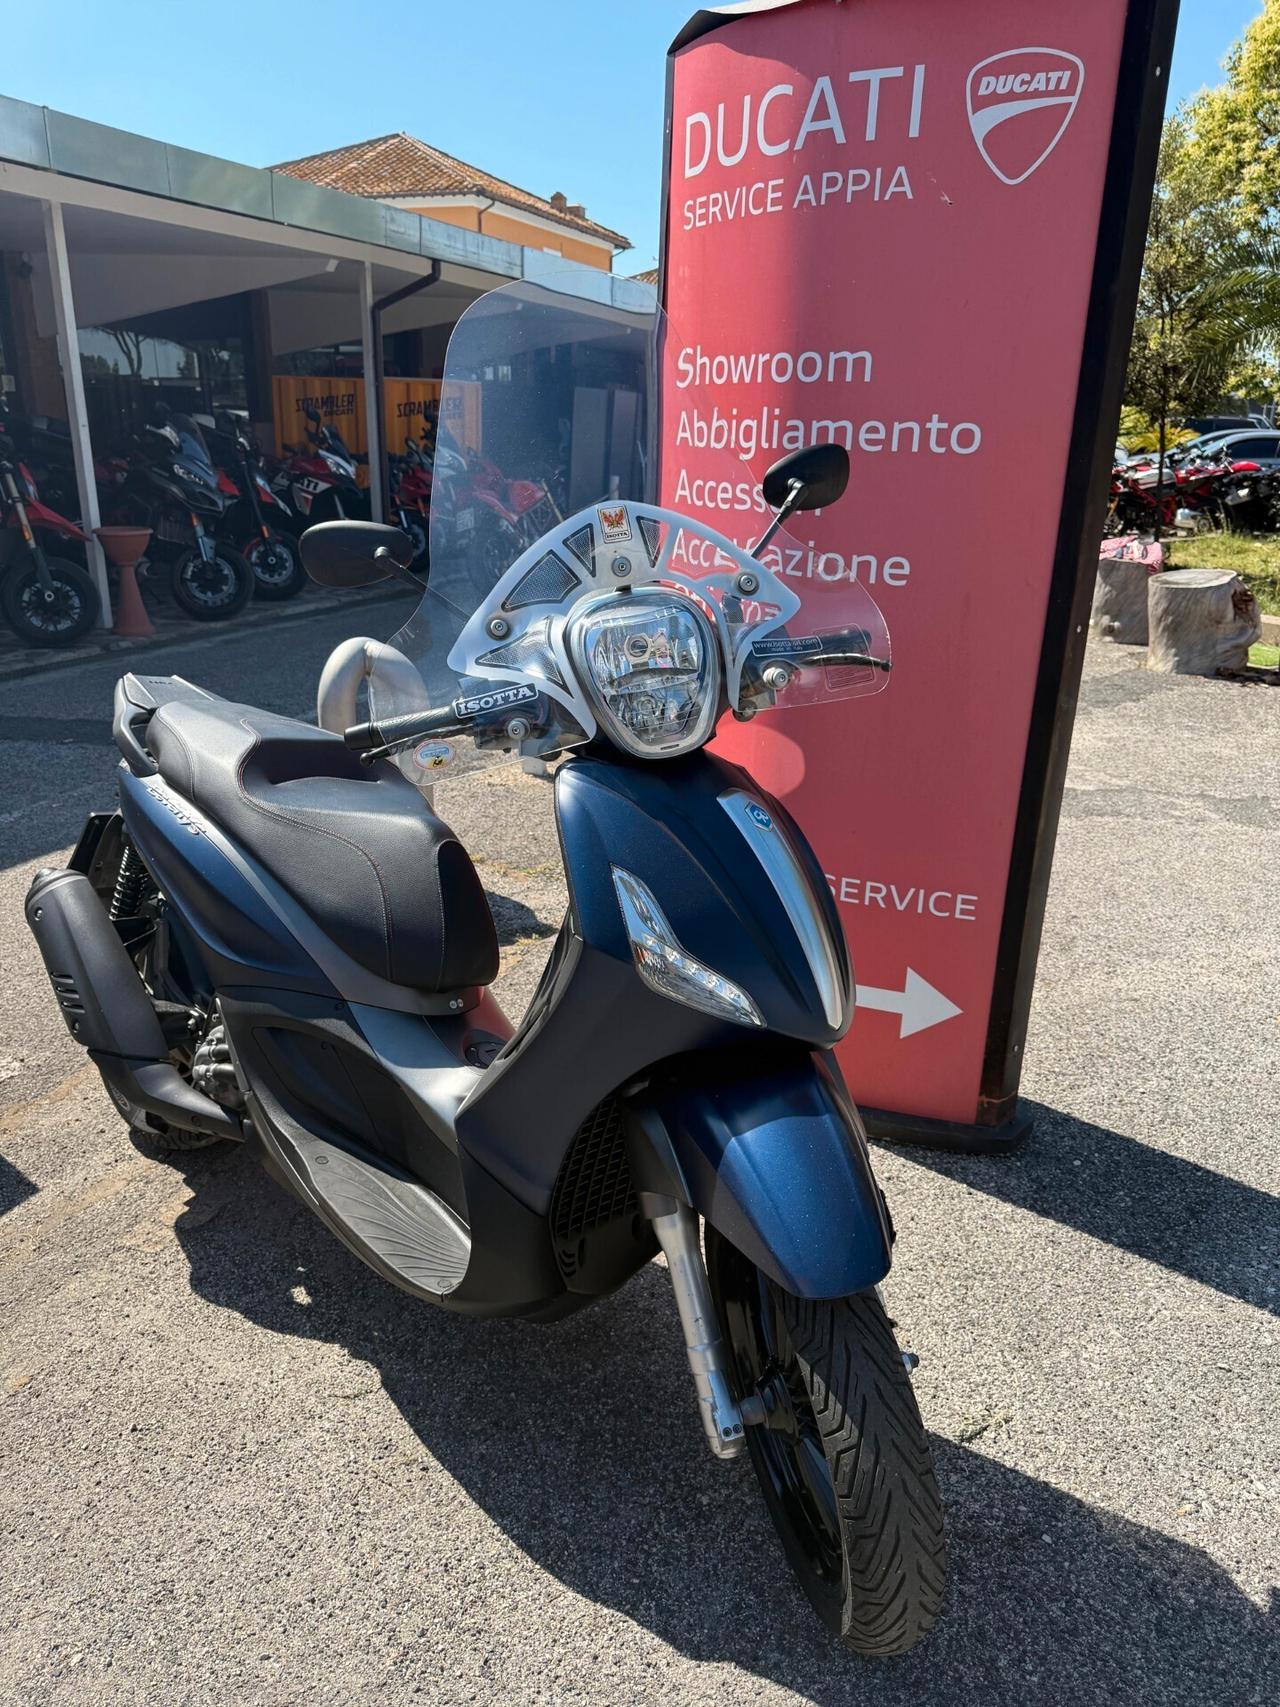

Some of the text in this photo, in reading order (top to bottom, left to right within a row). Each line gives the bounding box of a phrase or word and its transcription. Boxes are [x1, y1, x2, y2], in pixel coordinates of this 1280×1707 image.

[978, 70, 1072, 96] DUCATI
[684, 64, 926, 179] DUCATI
[683, 166, 914, 230] SERVICE APPIA
[675, 344, 873, 389] Showroom
[295, 393, 355, 412] SCRAMBLER
[675, 406, 982, 460] Abbigliamento
[674, 468, 821, 516] Access
[459, 686, 534, 715] ISOTTA
